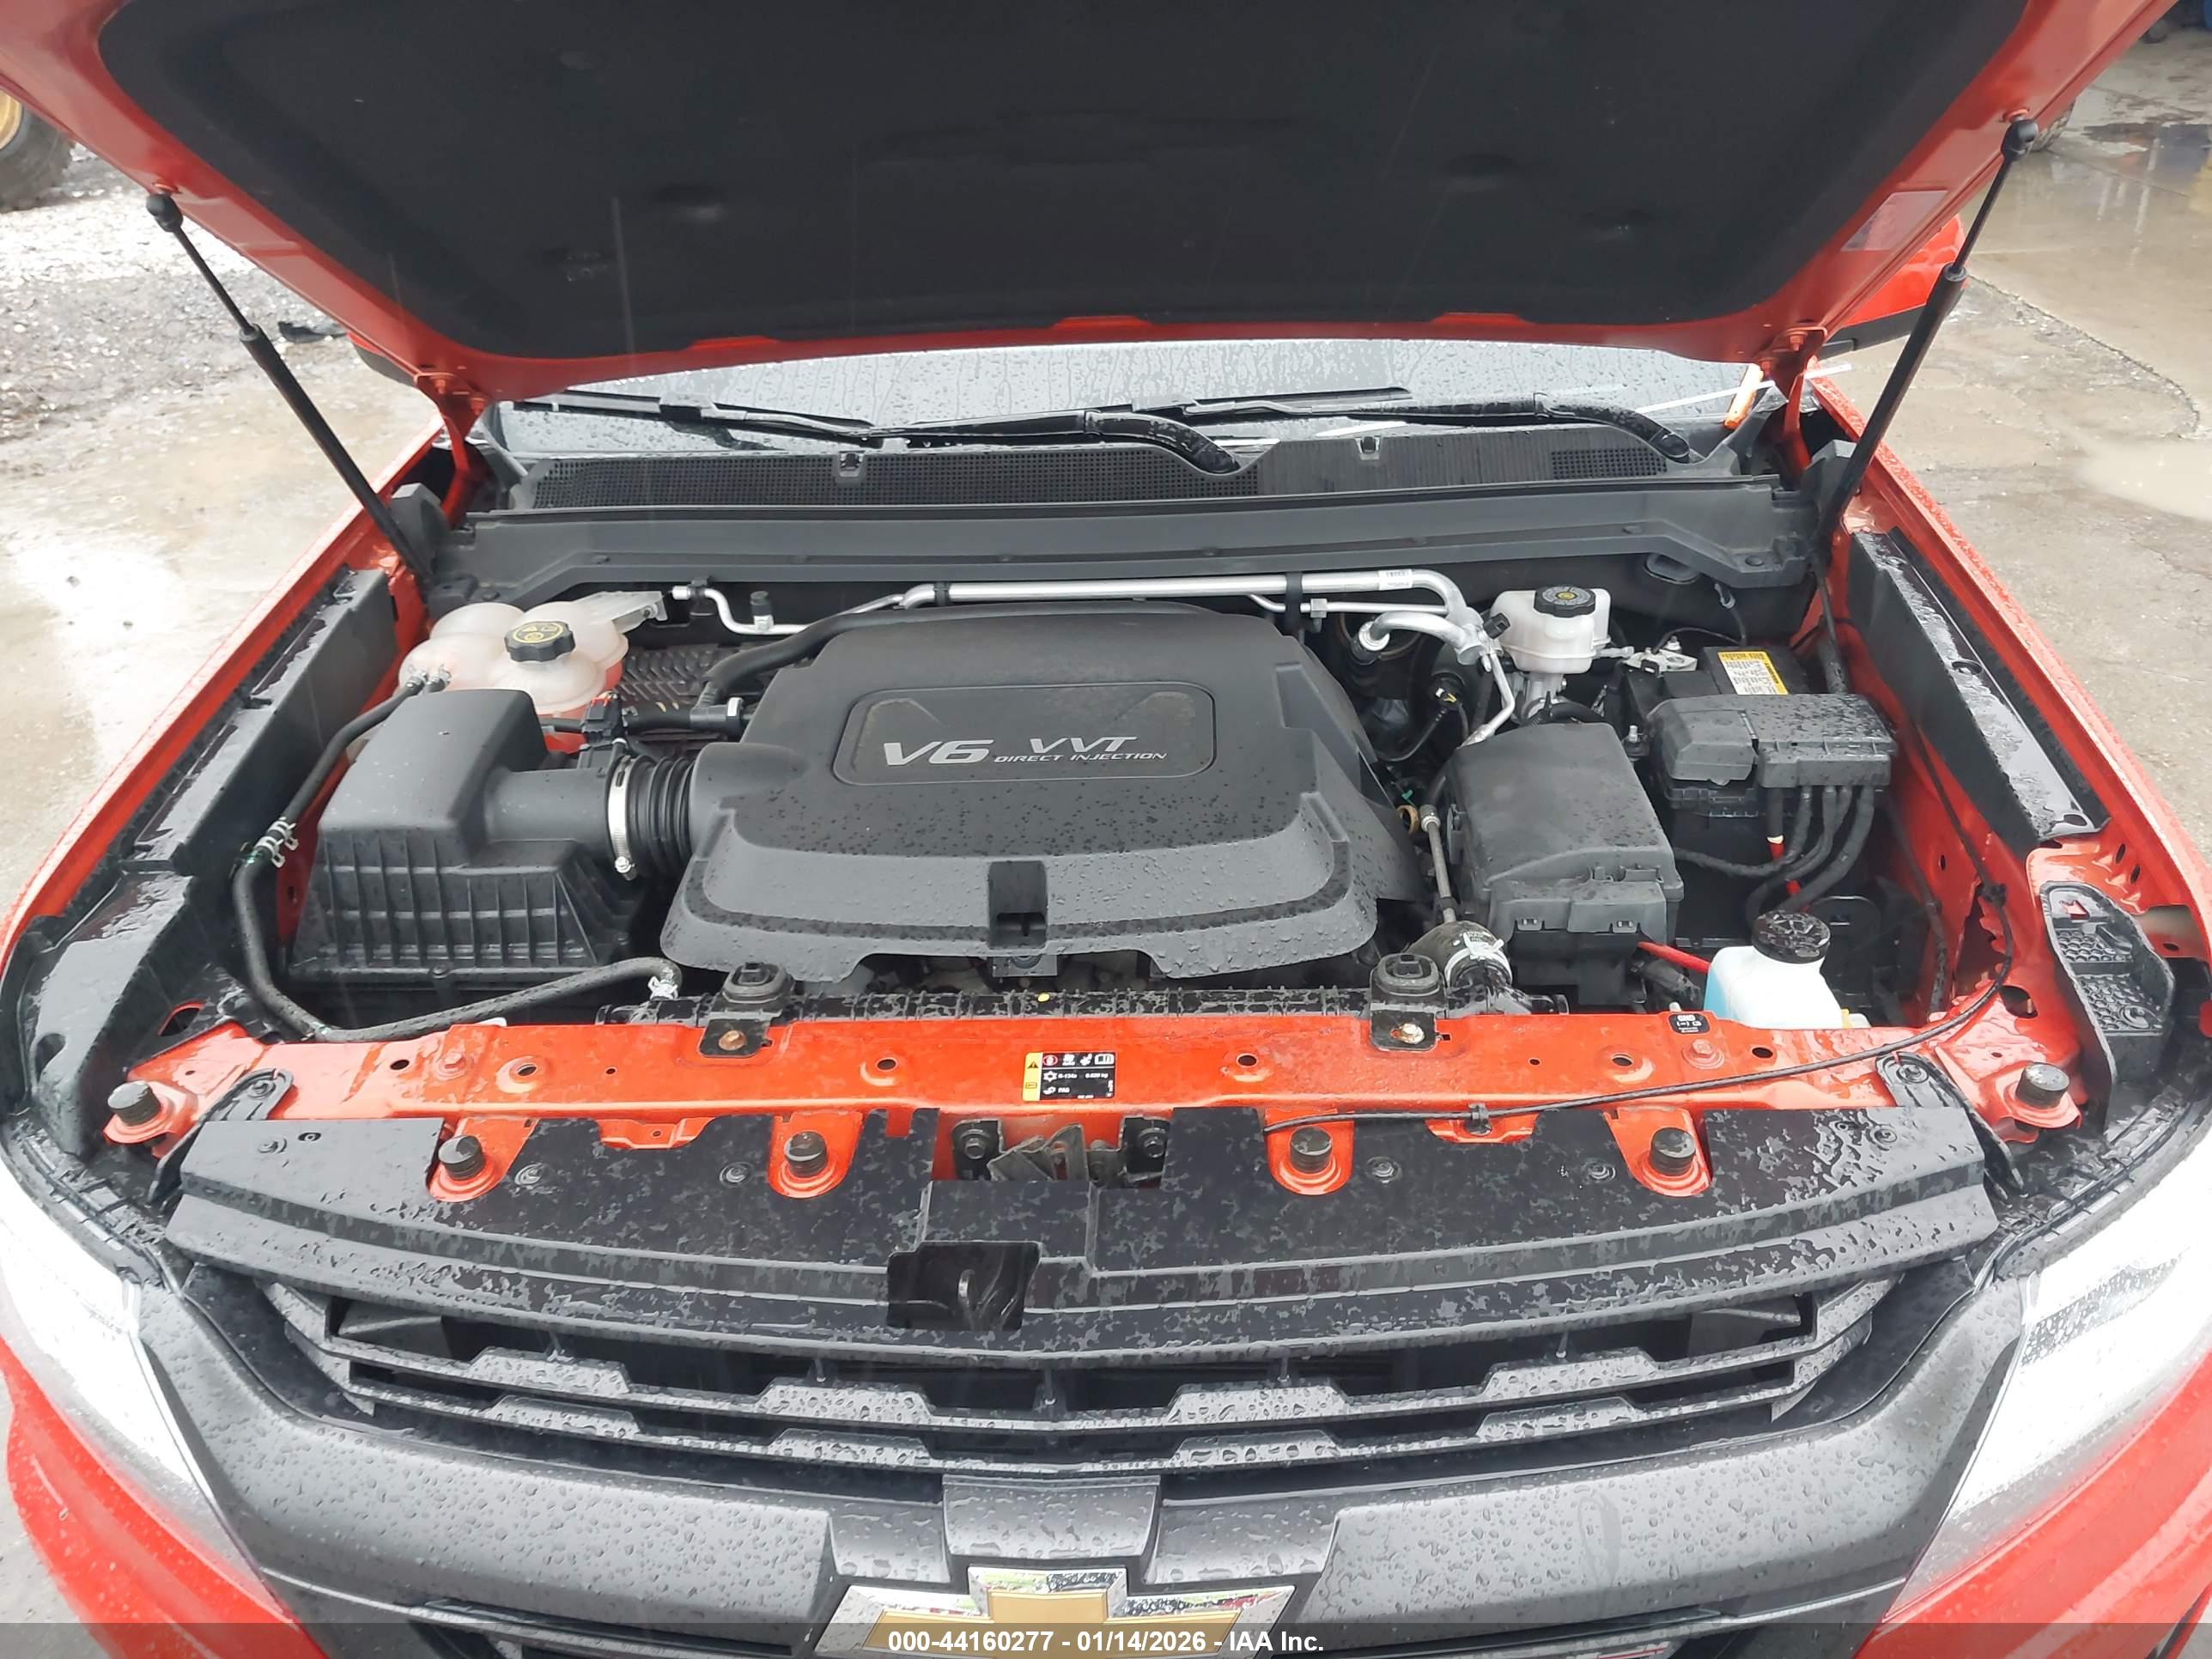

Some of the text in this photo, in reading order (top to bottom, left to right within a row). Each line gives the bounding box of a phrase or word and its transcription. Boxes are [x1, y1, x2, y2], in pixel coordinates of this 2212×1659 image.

[884, 736, 1138, 766] V6 VVT
[994, 751, 1168, 763] DIRECT INJECTION
